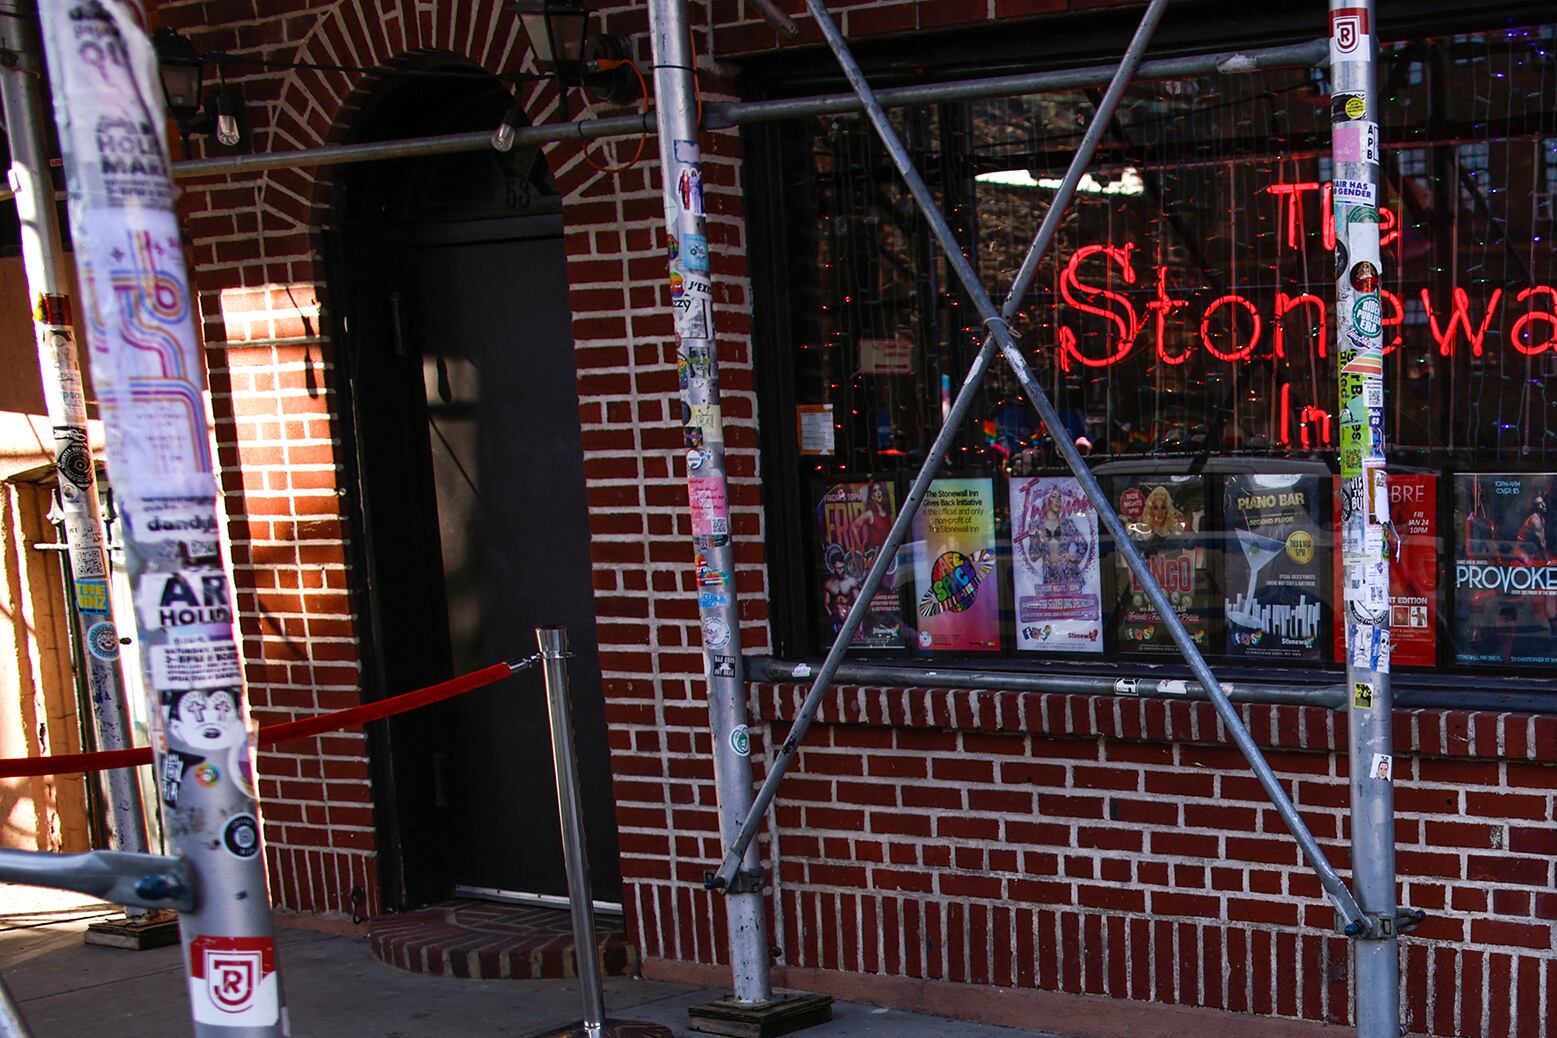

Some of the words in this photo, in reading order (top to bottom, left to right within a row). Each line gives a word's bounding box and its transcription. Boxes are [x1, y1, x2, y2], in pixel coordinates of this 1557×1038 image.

[1349, 182, 1368, 190] HAS
[1338, 188, 1372, 198] GENDER
[1360, 322, 1377, 333] ERA
[938, 490, 968, 498] Stonewall
[1391, 484, 1425, 503] BRE
[923, 499, 940, 507] Gives
[956, 498, 982, 506] Initiative
[1237, 494, 1276, 511] PIANO
[1278, 492, 1306, 506] BAR
[970, 507, 984, 516] only
[935, 517, 964, 525] non-profit
[1249, 517, 1274, 526] SECOND
[1274, 516, 1294, 525] FLOOR
[1410, 526, 1428, 534] 10PM
[160, 573, 227, 607] AR
[1398, 597, 1428, 605] EDITION
